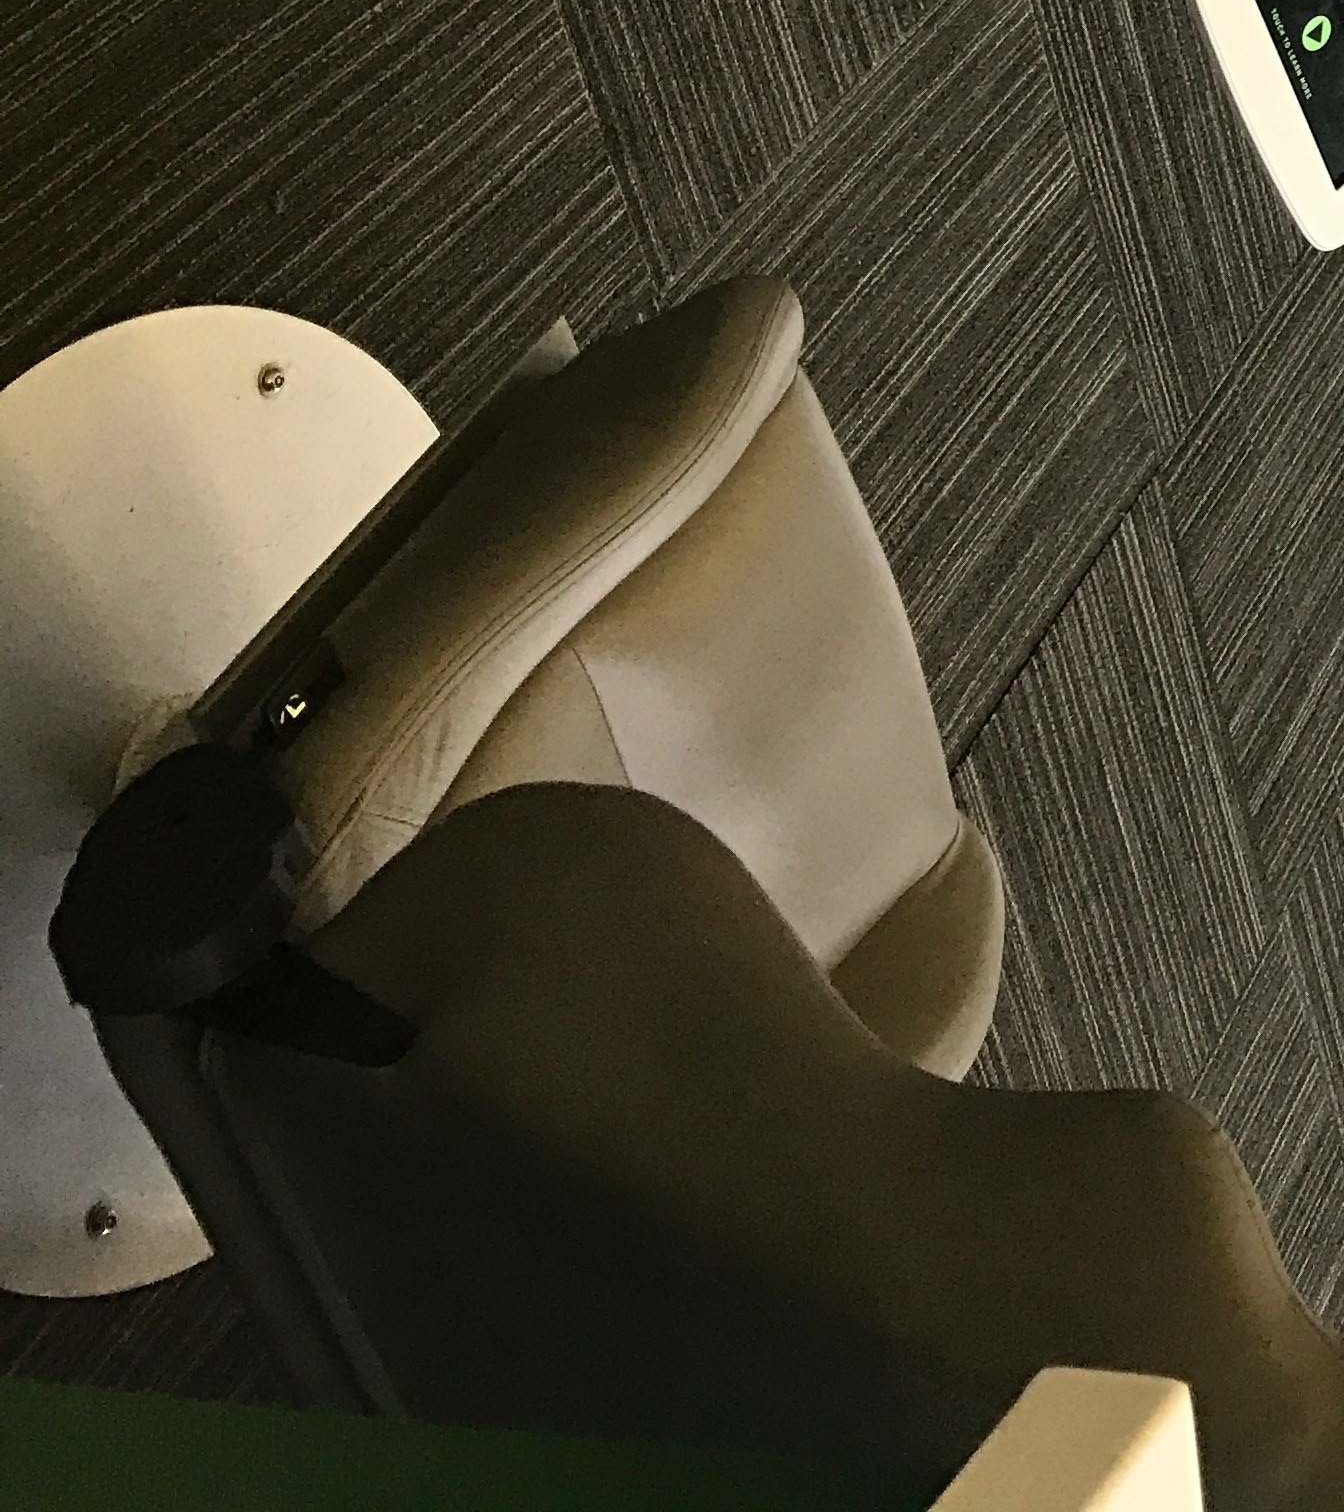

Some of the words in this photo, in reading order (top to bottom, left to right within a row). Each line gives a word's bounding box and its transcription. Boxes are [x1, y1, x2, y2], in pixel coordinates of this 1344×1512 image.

[1271, 7, 1286, 37] TOUCH
[1282, 36, 1291, 49] TO
[1287, 48, 1303, 77] LEARN
[1299, 76, 1313, 100] MORE
